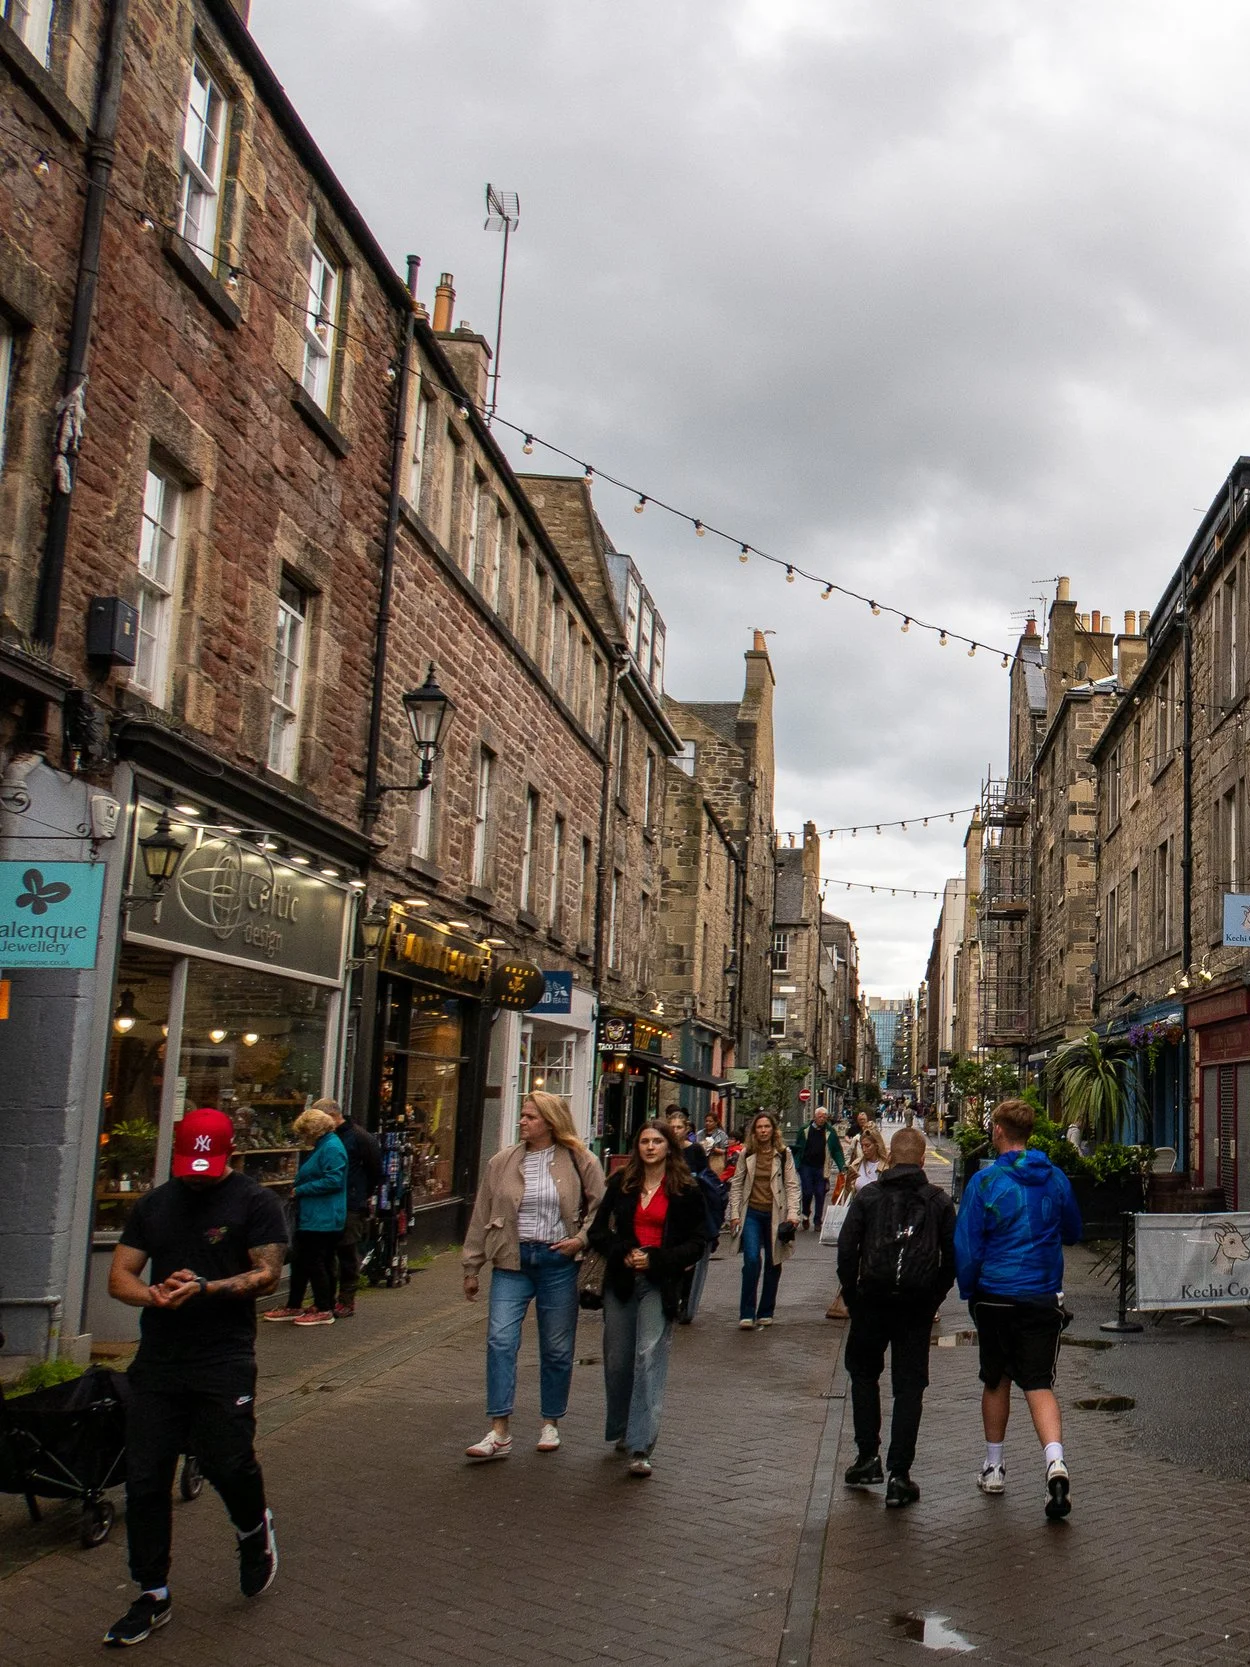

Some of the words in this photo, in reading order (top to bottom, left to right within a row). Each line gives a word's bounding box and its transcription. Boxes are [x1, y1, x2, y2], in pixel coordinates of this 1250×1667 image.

[248, 876, 299, 923] Celtic
[0, 921, 87, 943] alenque
[243, 918, 282, 958] design
[1226, 934, 1247, 942] Kechi
[0, 941, 69, 955] Jewellery
[194, 1135, 211, 1152] NY
[1181, 1284, 1224, 1299] Kechi
